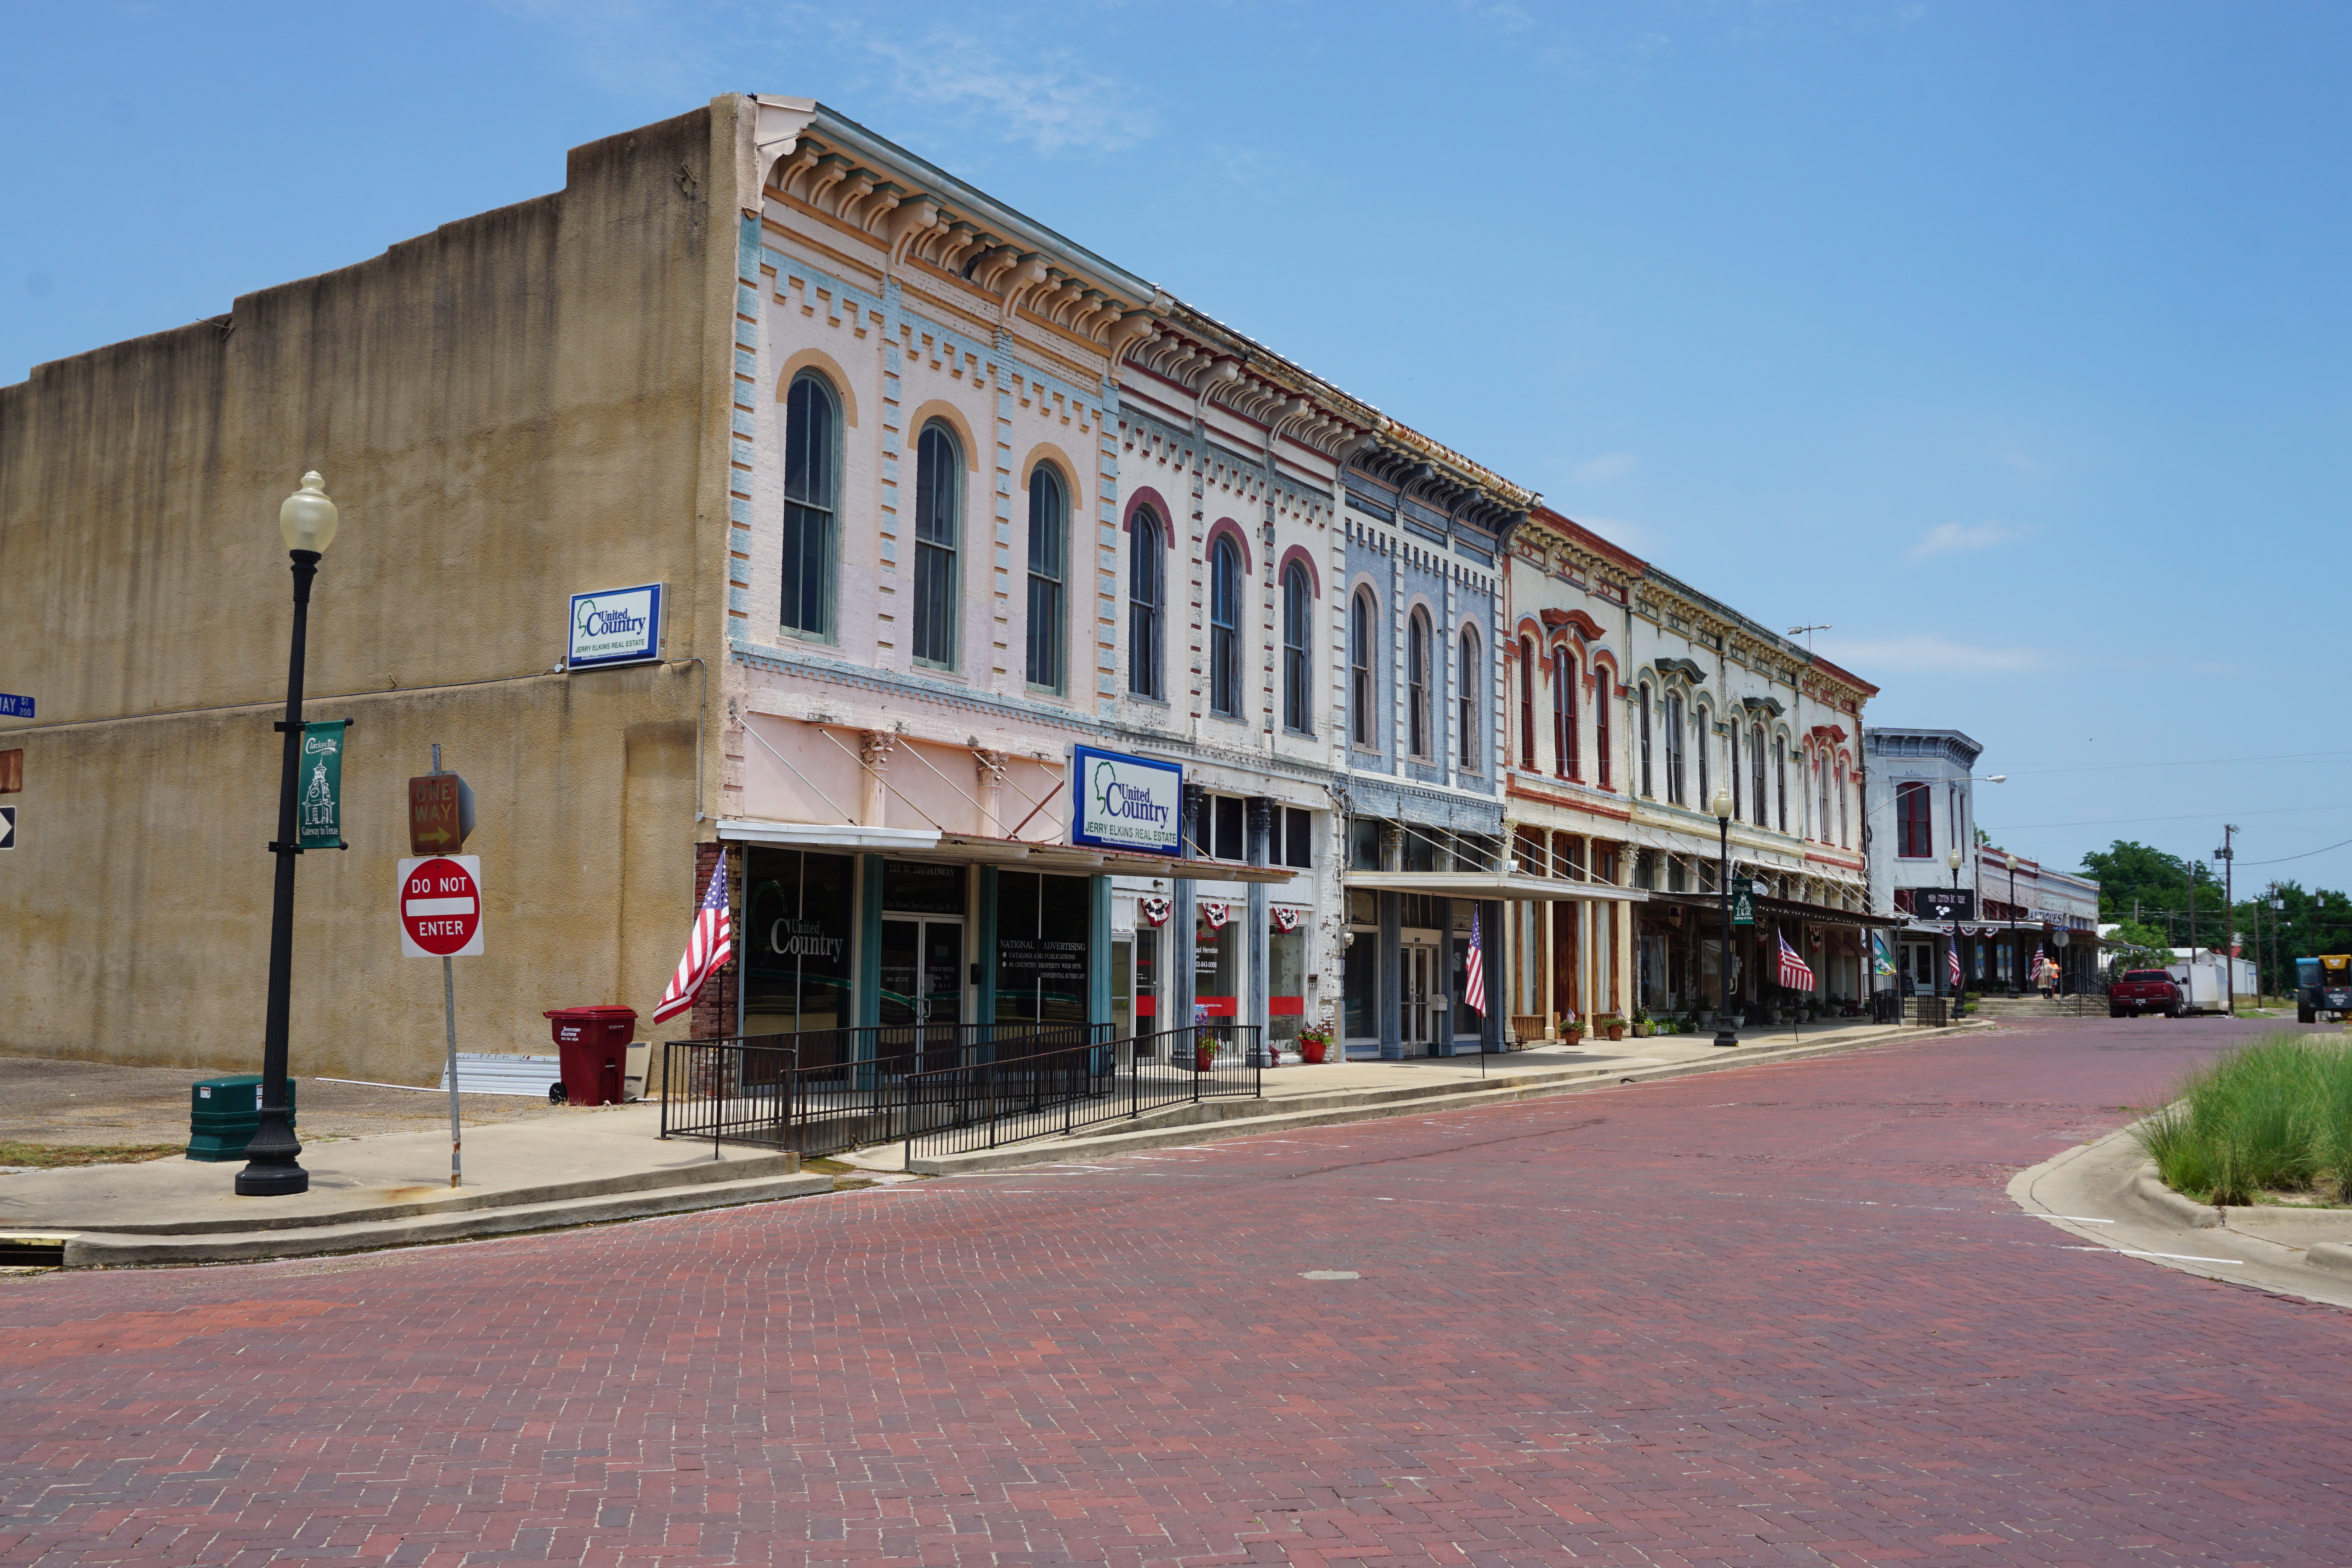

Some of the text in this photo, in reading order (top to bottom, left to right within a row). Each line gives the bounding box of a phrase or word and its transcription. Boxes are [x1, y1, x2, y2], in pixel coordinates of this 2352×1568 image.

[601, 608, 628, 622] United
[587, 612, 646, 636] Country
[21, 697, 29, 706] ST
[306, 737, 337, 754] Clarksville
[416, 783, 451, 802] ONE
[1122, 784, 1150, 803] United
[415, 803, 452, 822] WAY
[1106, 782, 1169, 829] Country
[302, 826, 319, 838] Gateway
[325, 826, 338, 835] Texas
[1085, 822, 1176, 844] JERRY ELKINS REAL ESTATE
[903, 865, 911, 873] W.
[913, 866, 955, 877] BROADWAY
[412, 877, 466, 893] DO NOT
[919, 902, 935, 911] Country
[1938, 894, 1949, 903] COTTON
[419, 920, 463, 936] ENTER
[791, 919, 820, 934] United
[771, 918, 843, 963] Country
[1000, 940, 1085, 951] NATIONAL ADVERTISING
